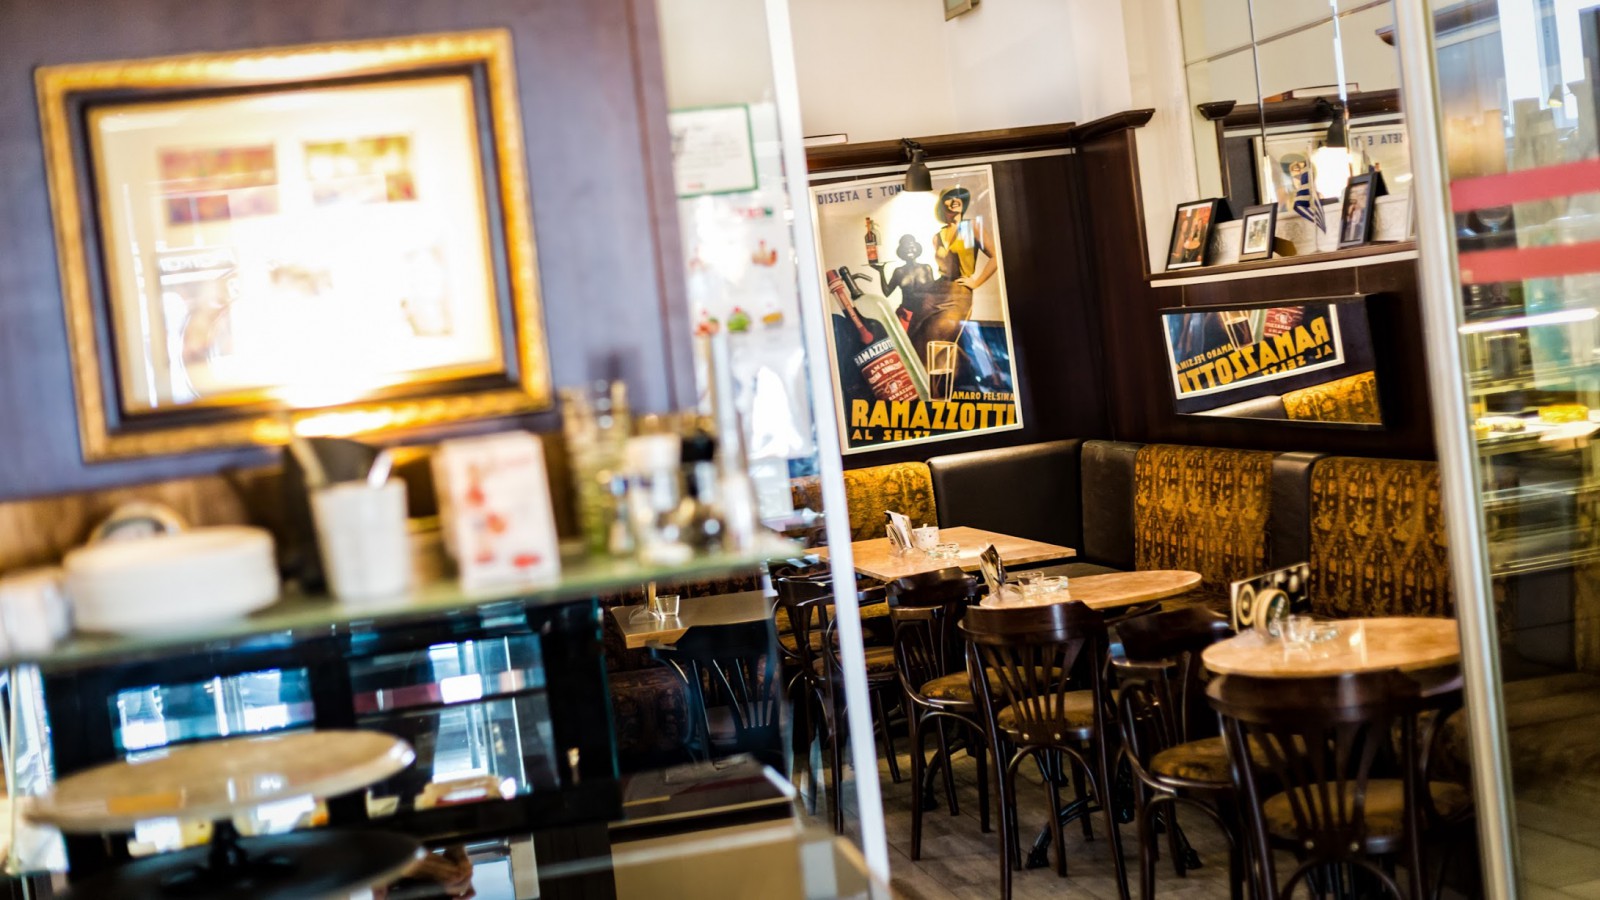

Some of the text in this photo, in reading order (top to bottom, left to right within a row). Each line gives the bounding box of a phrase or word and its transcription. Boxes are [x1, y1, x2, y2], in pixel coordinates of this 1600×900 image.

[818, 191, 860, 204] DISSETA
[867, 188, 873, 199] E
[854, 339, 894, 367] RAMAZZOTT
[870, 358, 895, 375] AMARO
[952, 391, 981, 401] AMARO
[852, 399, 1016, 431] RAMAZZOTTI
[852, 429, 874, 441] AL
